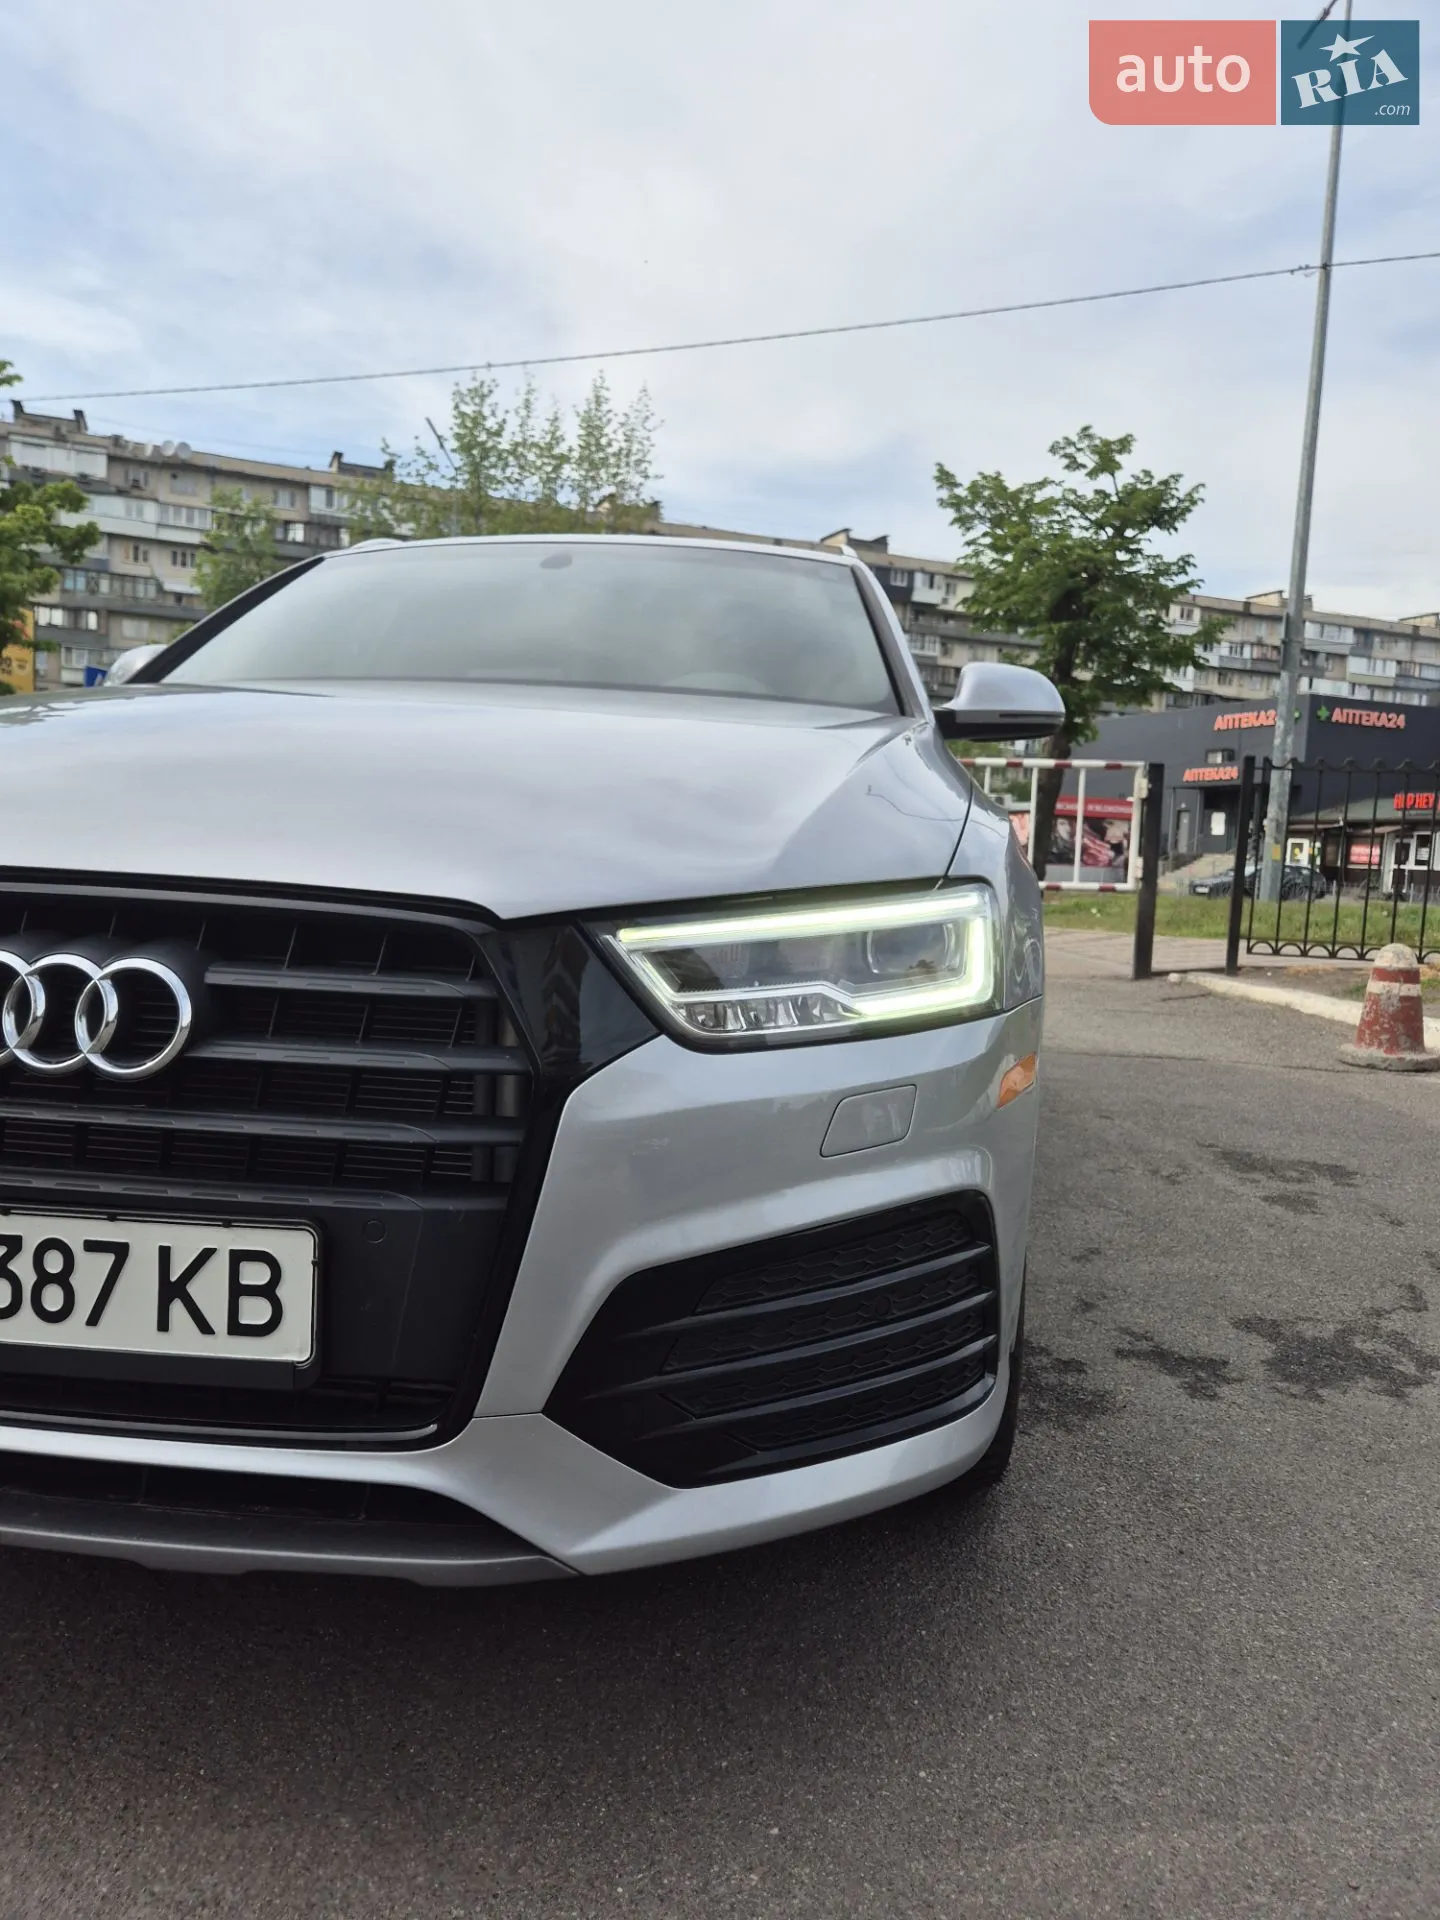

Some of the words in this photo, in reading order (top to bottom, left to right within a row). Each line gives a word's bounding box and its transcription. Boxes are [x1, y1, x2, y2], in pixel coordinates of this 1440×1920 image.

[1213, 709, 1278, 731] АПТЕКА2
[1331, 707, 1406, 729] АПТЕКА24
[1183, 766, 1239, 782] АПТЕКА24
[156, 1244, 284, 1338] KB
